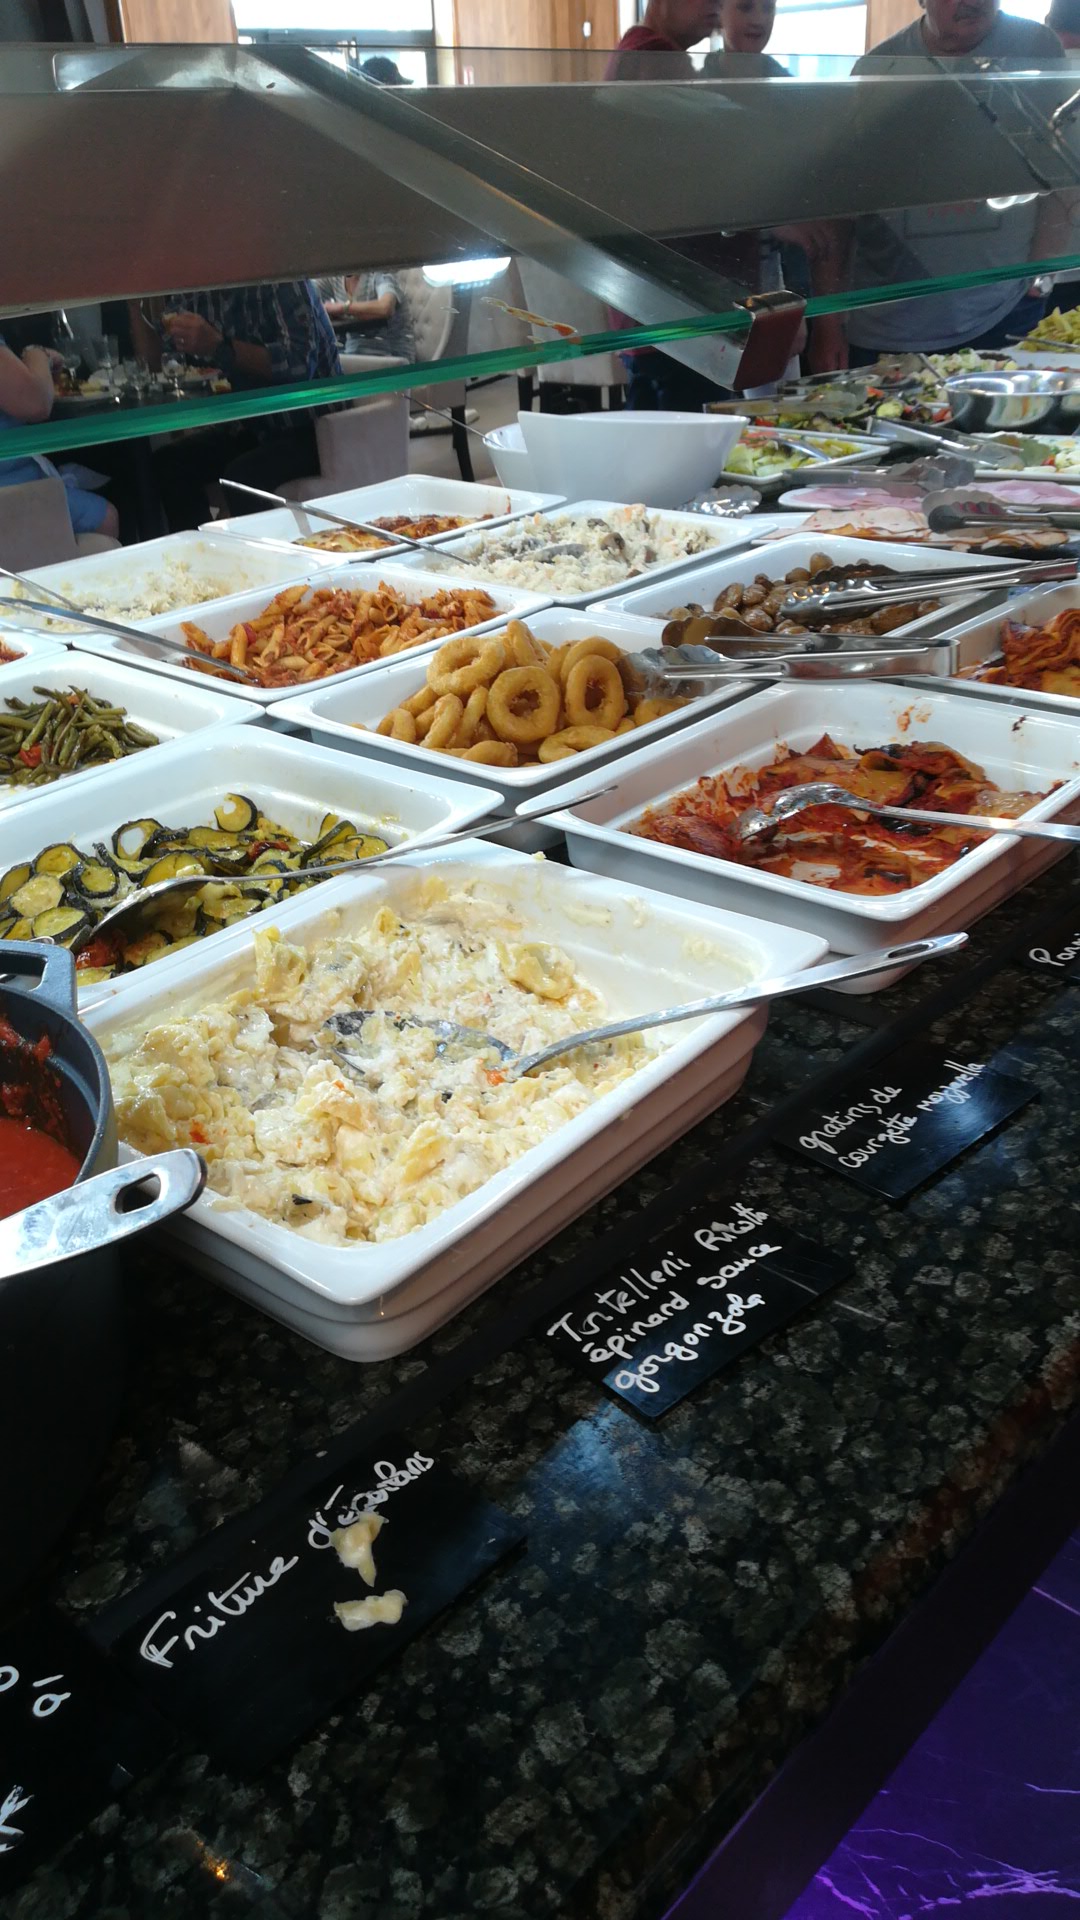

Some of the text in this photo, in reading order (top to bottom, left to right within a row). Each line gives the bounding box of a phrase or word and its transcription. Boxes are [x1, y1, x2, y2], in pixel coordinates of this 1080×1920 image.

[799, 1085, 902, 1154] gratins de
[838, 1112, 918, 1169] courgette
[139, 1555, 299, 1668] Friture
